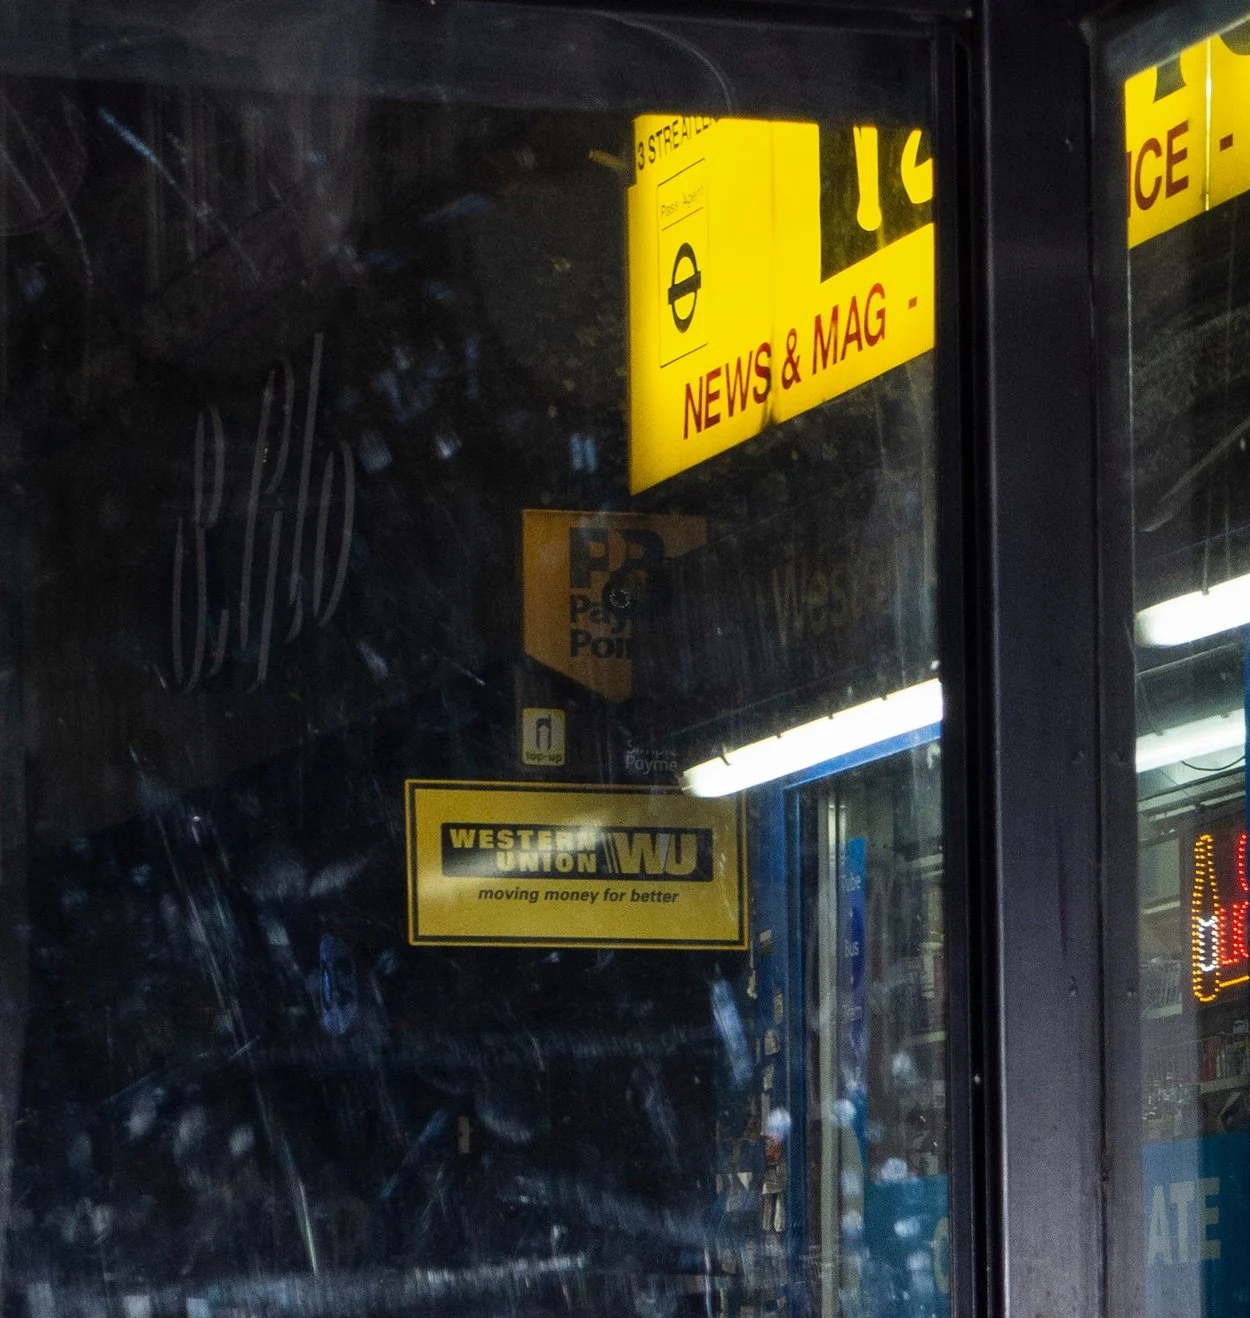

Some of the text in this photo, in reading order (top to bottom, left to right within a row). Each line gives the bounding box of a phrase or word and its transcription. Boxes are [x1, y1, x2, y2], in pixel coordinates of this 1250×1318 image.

[683, 341, 773, 440] NEWS
[781, 327, 802, 390] &
[811, 282, 886, 376] MAG
[626, 754, 678, 777] Payme
[450, 828, 698, 876] WESTERN WU
[496, 851, 597, 873] UNION
[478, 887, 680, 904] moving money for better
